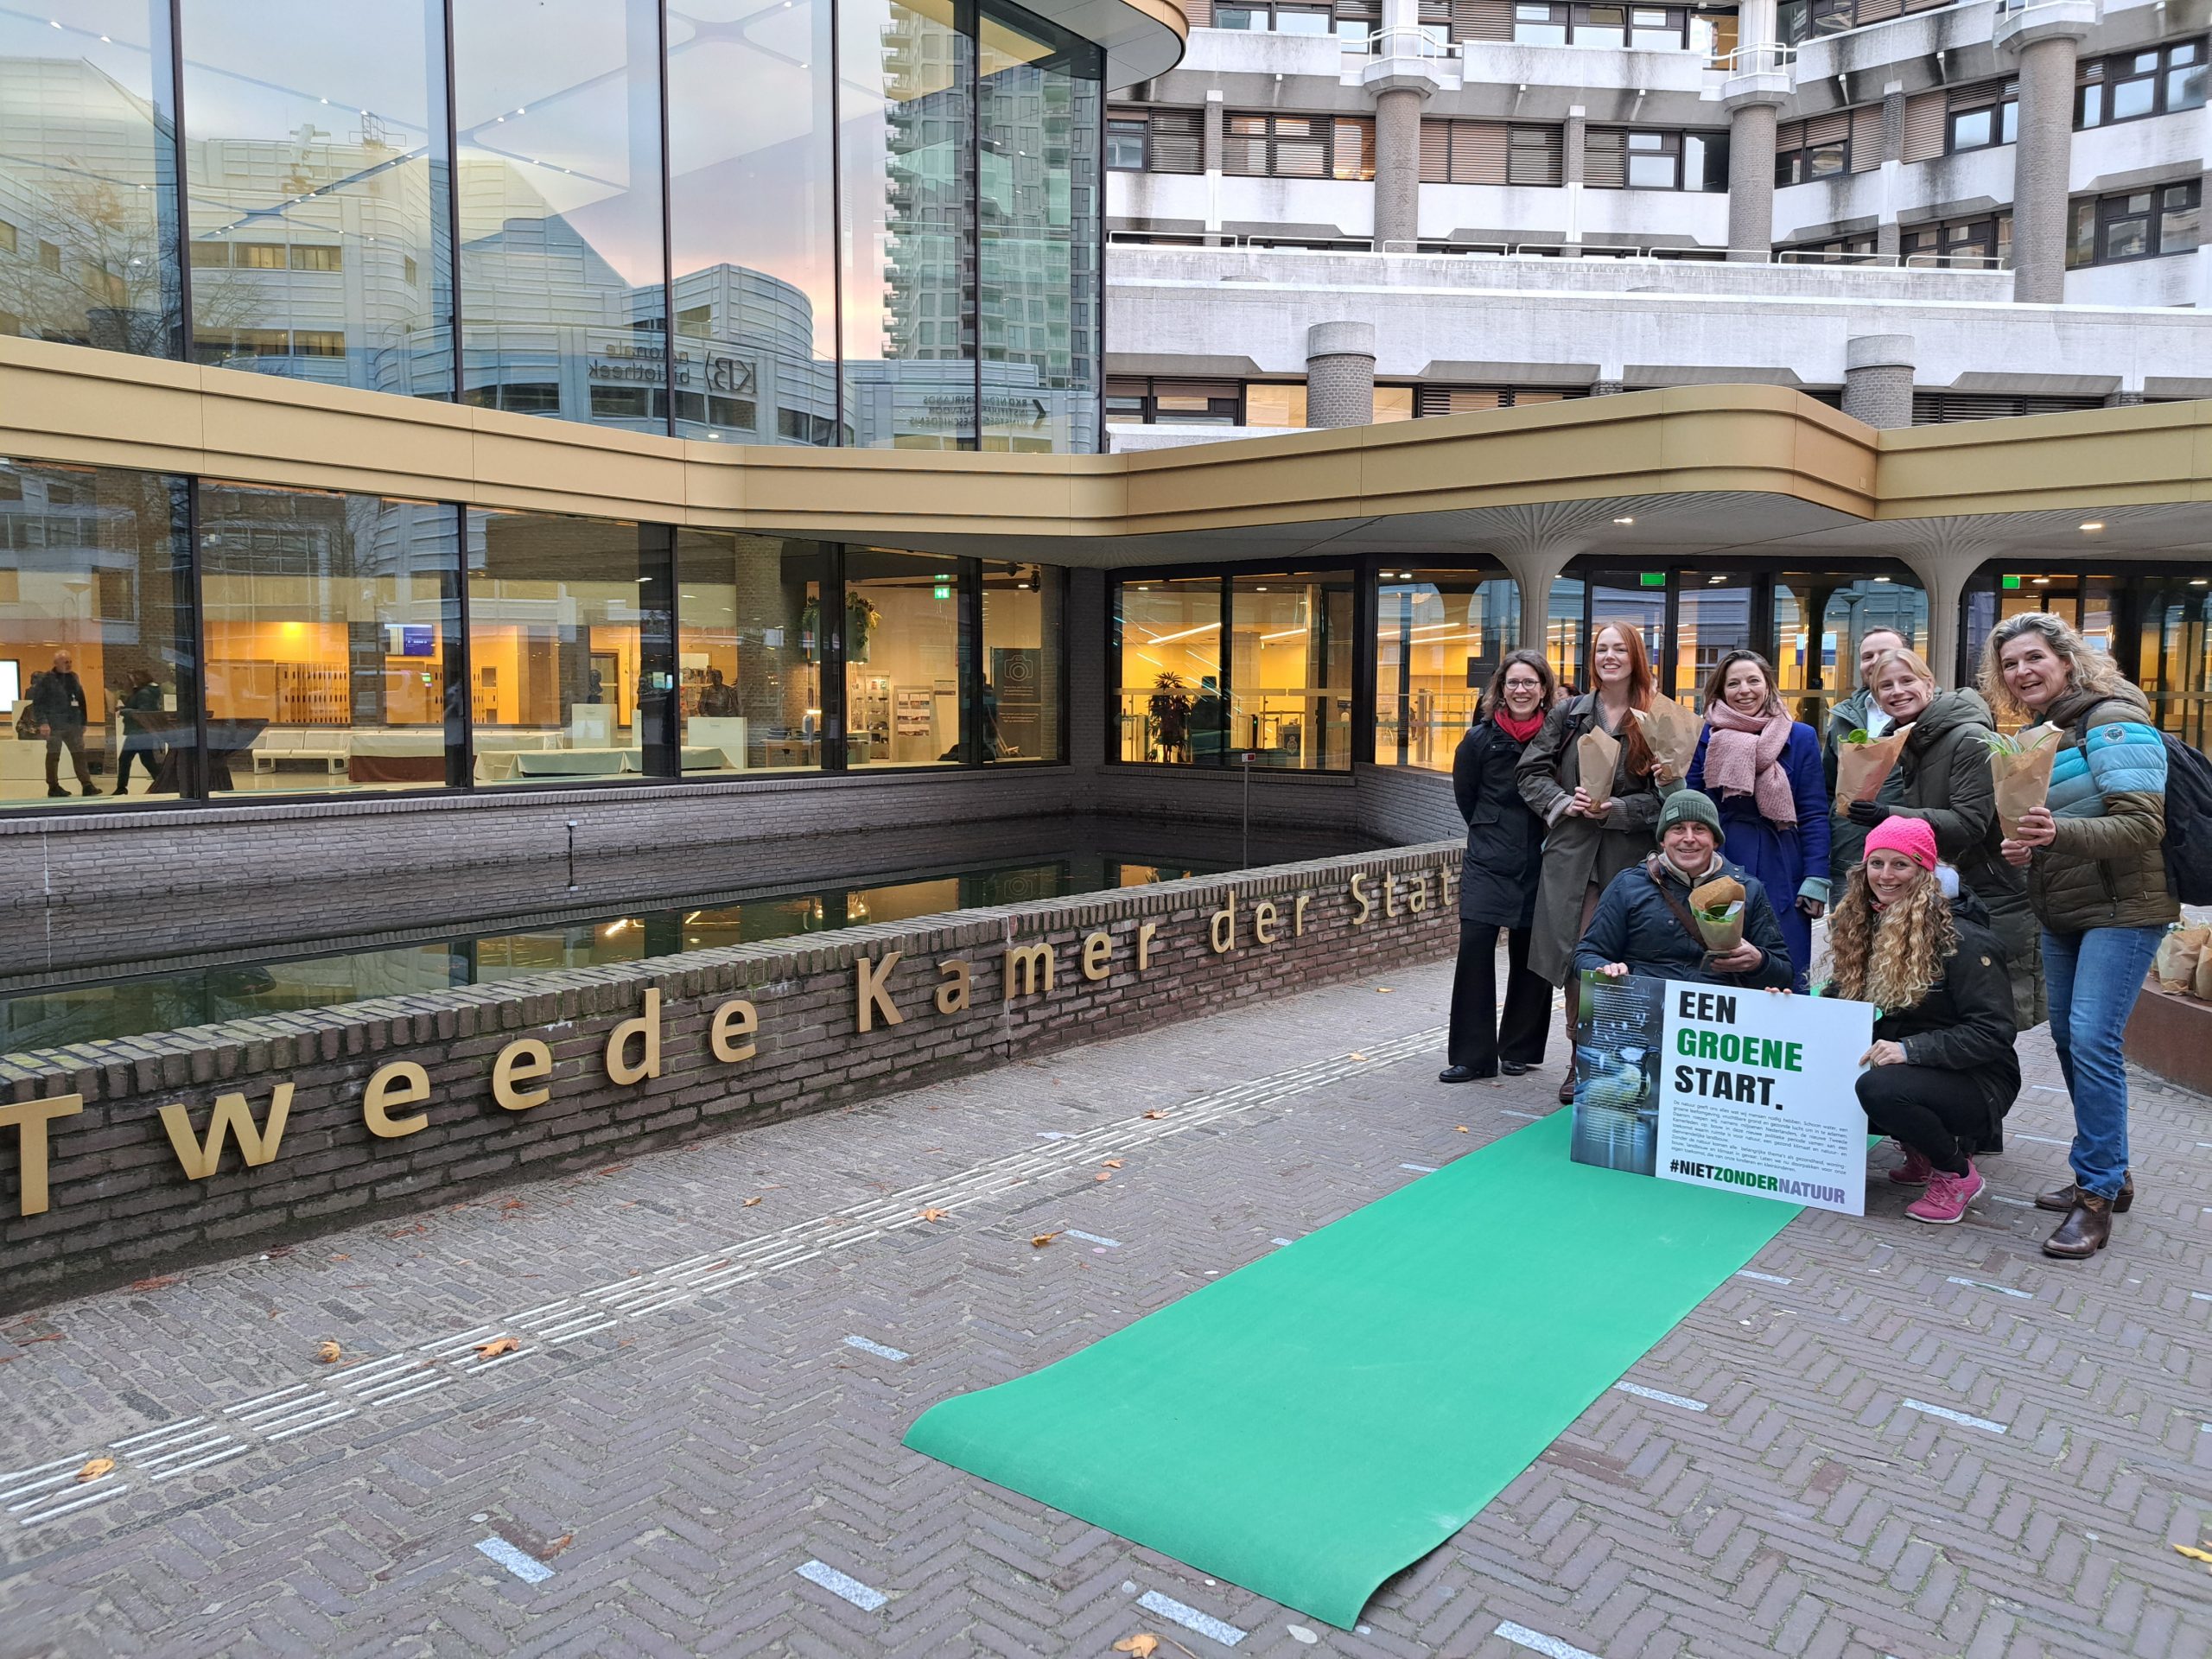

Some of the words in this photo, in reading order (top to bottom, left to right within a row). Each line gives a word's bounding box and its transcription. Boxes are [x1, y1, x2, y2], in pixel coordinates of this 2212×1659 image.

[1679, 991, 1736, 1024] EEN
[0, 988, 759, 1216] Tweede
[856, 951, 1156, 1033] Kamer
[1210, 890, 1309, 954] der
[1350, 862, 1452, 925] Stat
[1677, 1028, 1803, 1071] GROENE
[1675, 1065, 1783, 1110] START.
[1669, 1160, 1846, 1204] #NIETZONDERNATUUR
